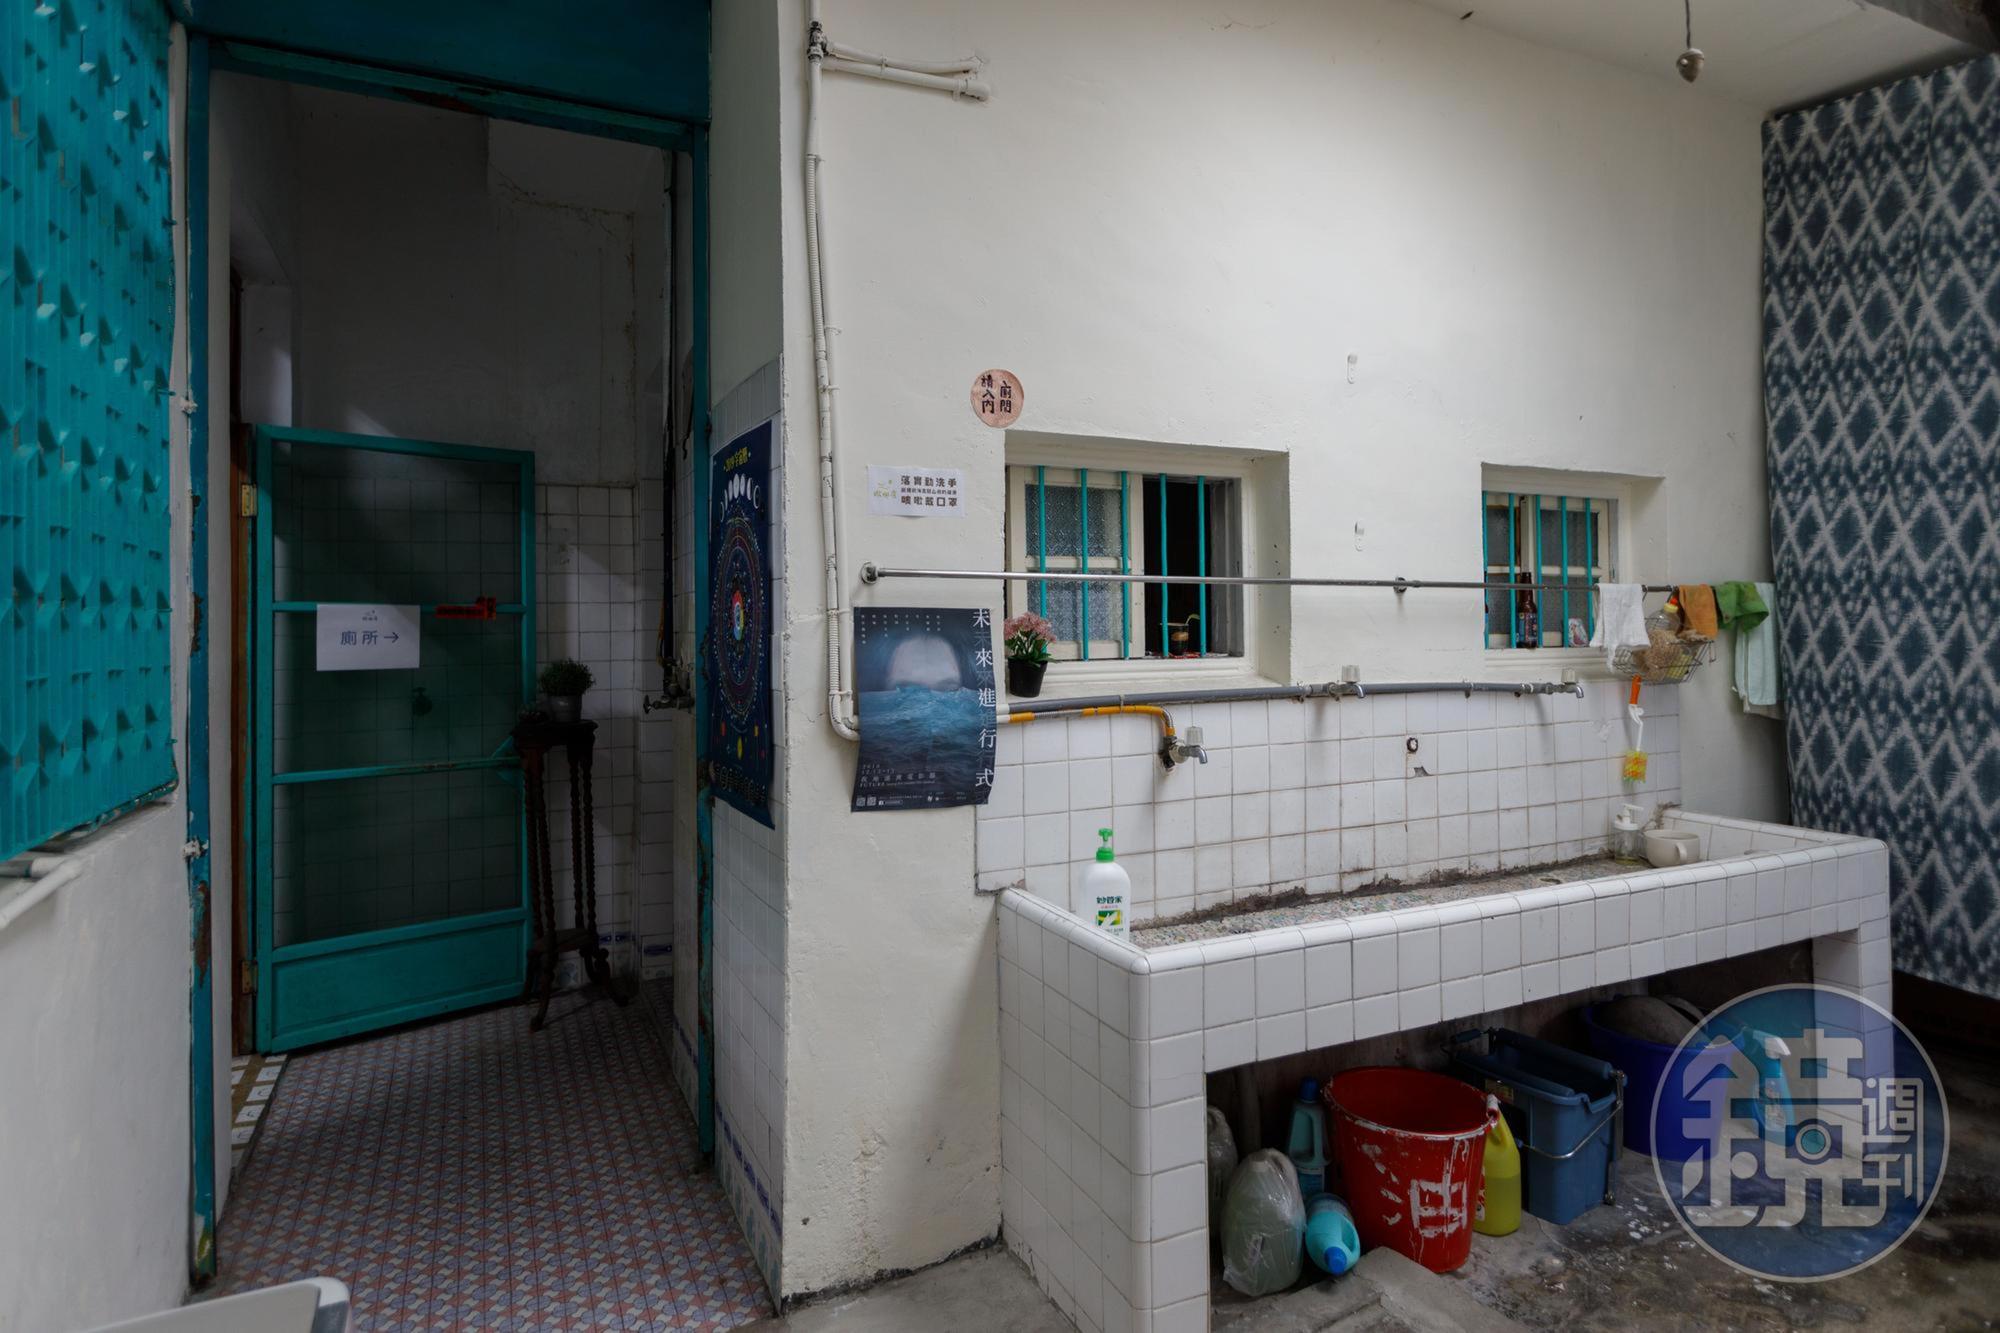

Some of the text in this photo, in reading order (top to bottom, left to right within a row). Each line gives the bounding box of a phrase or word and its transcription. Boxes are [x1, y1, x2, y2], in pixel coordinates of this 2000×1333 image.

[341, 630, 379, 646] 廁所
[973, 608, 997, 788] 未來進行式
